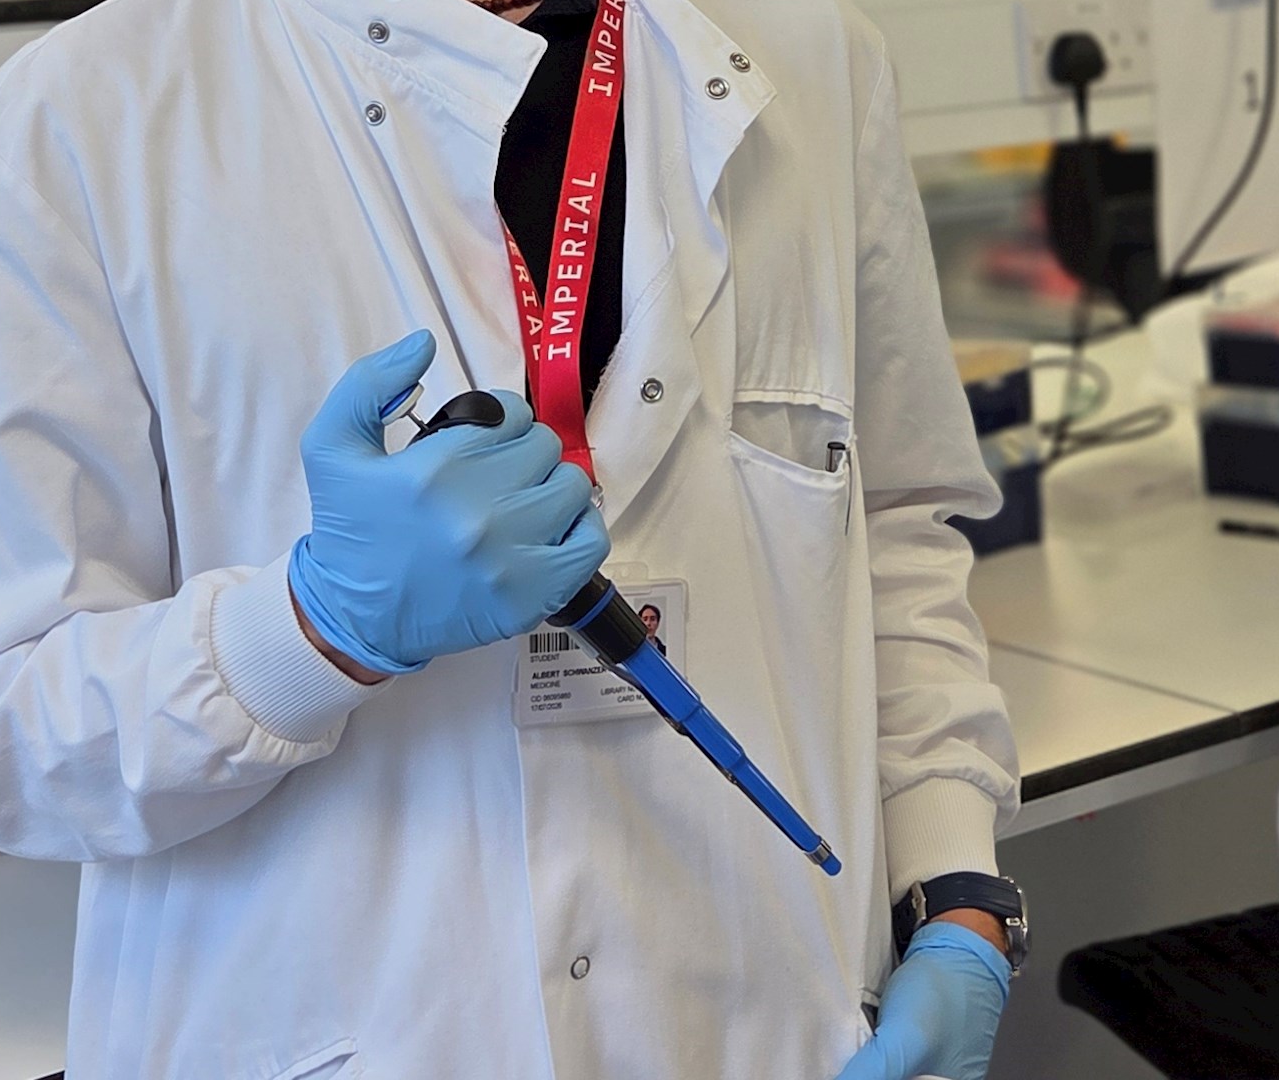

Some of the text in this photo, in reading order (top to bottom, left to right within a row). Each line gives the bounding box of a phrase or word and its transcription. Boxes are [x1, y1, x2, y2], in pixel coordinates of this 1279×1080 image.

[548, 172, 597, 361] IMPERIAL
[530, 653, 560, 663] STUDENT
[532, 670, 560, 680] ALBERT
[530, 680, 561, 689] MEDICINE
[617, 694, 635, 703] CARD
